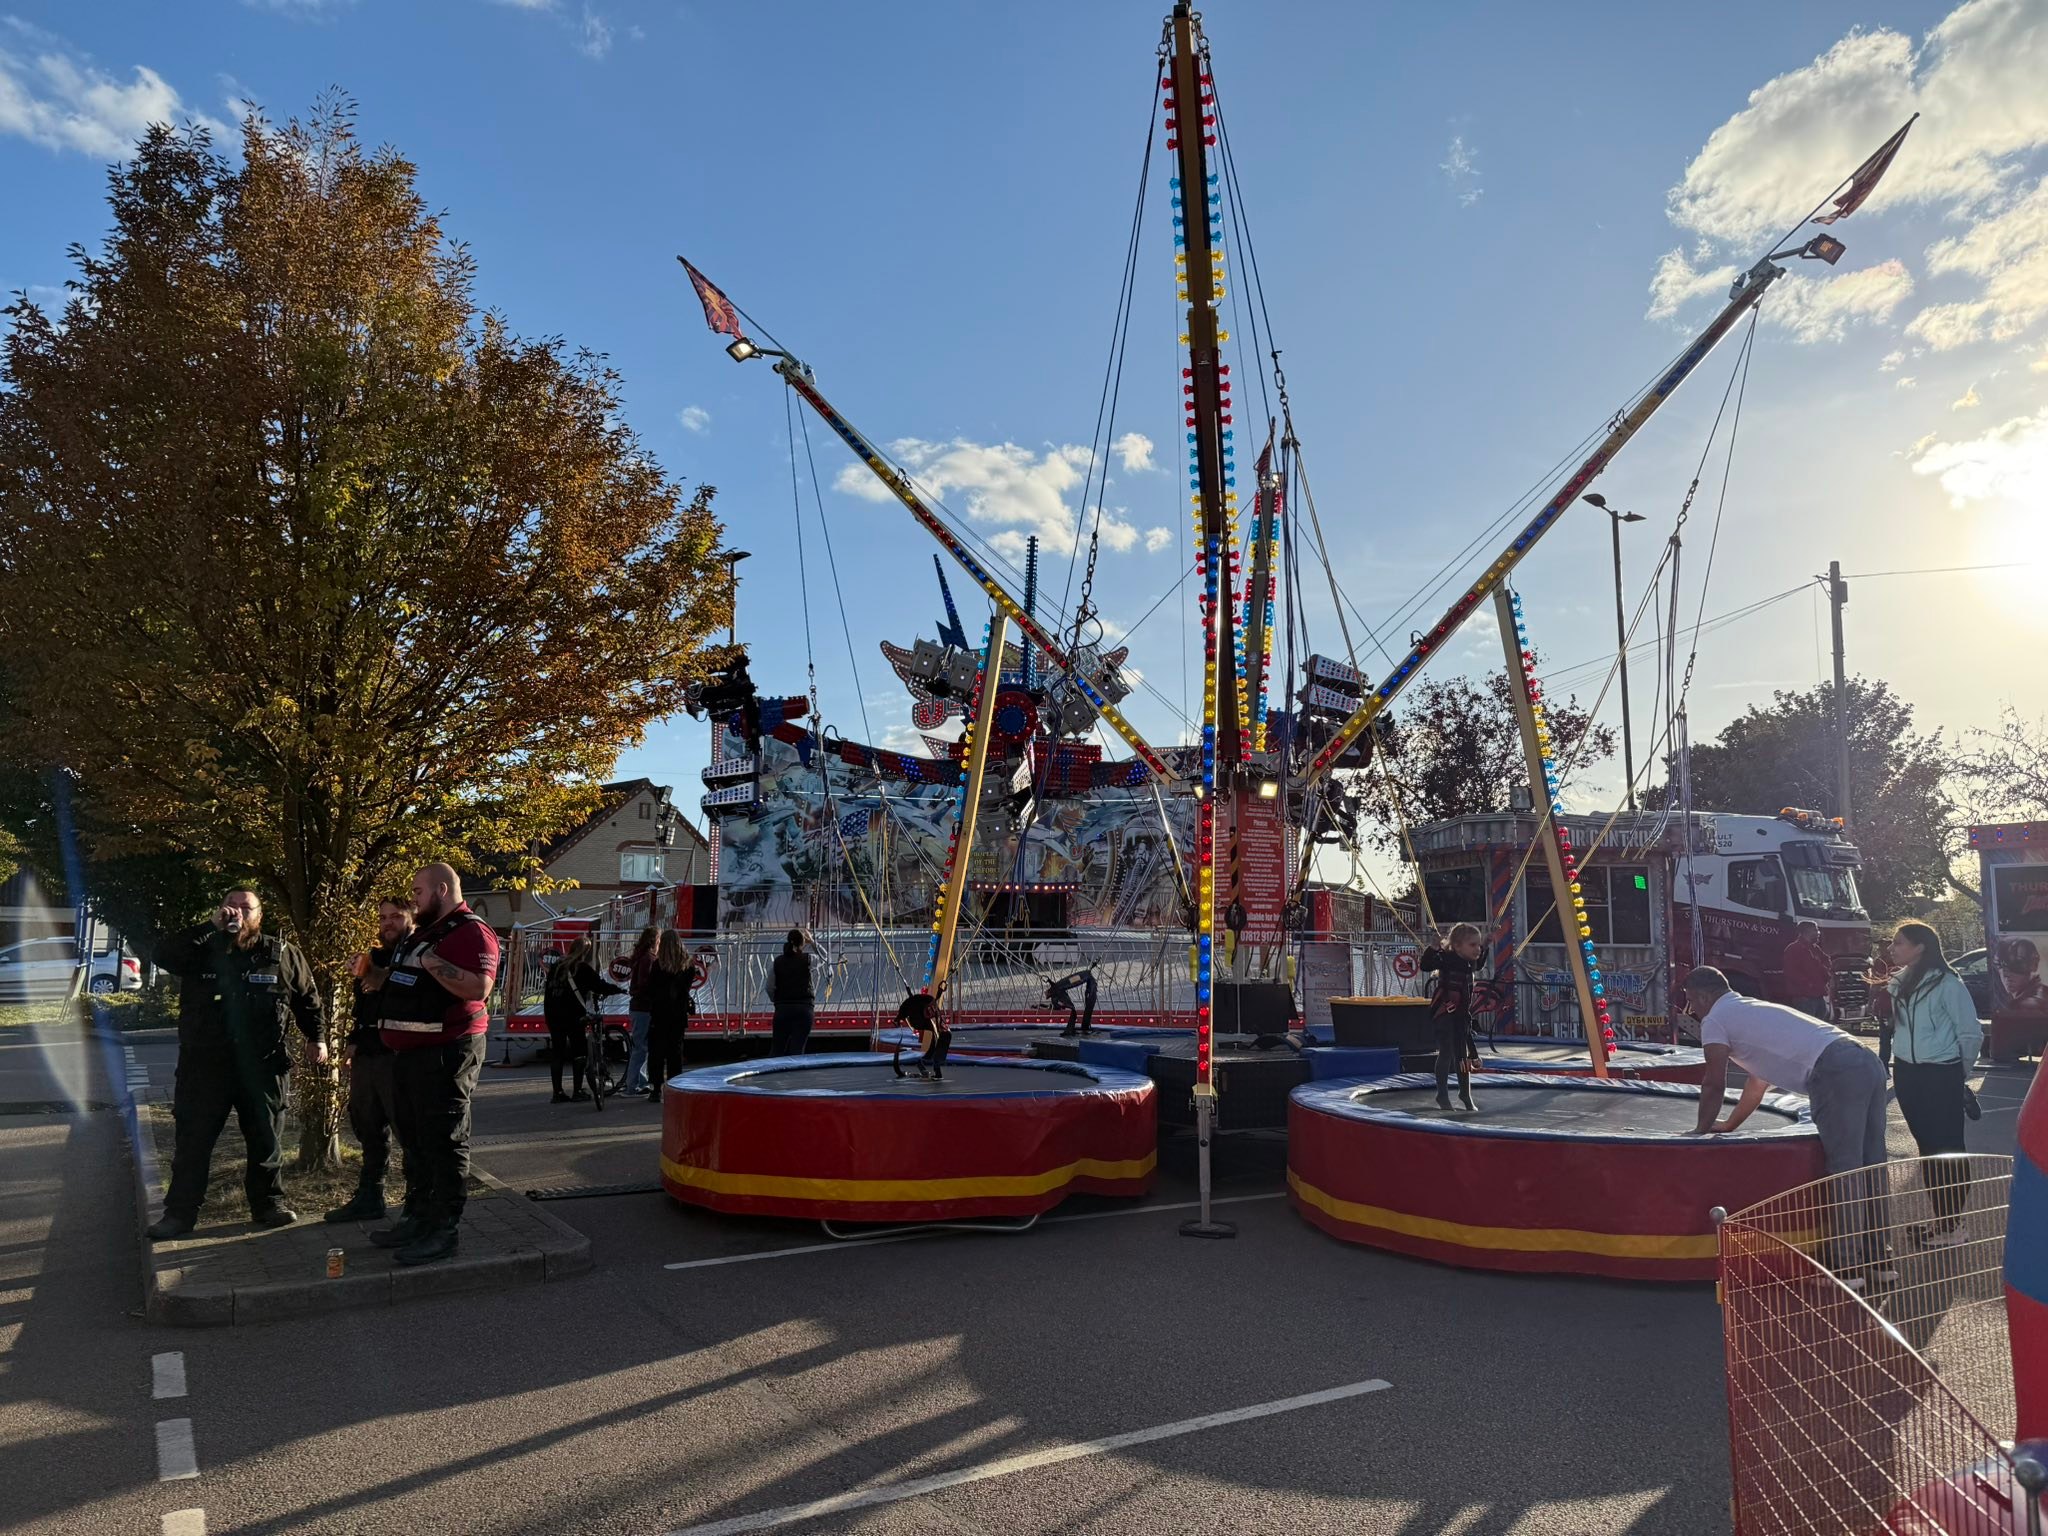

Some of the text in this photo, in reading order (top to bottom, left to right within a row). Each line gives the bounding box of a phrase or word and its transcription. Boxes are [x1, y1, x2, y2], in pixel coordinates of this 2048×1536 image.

[1717, 840, 1733, 848] 520
[1704, 914, 1750, 930] THURSTON
[1751, 923, 1759, 932] &
[1760, 925, 1779, 935] SON
[696, 954, 715, 964] STOP
[612, 964, 632, 974] STOP
